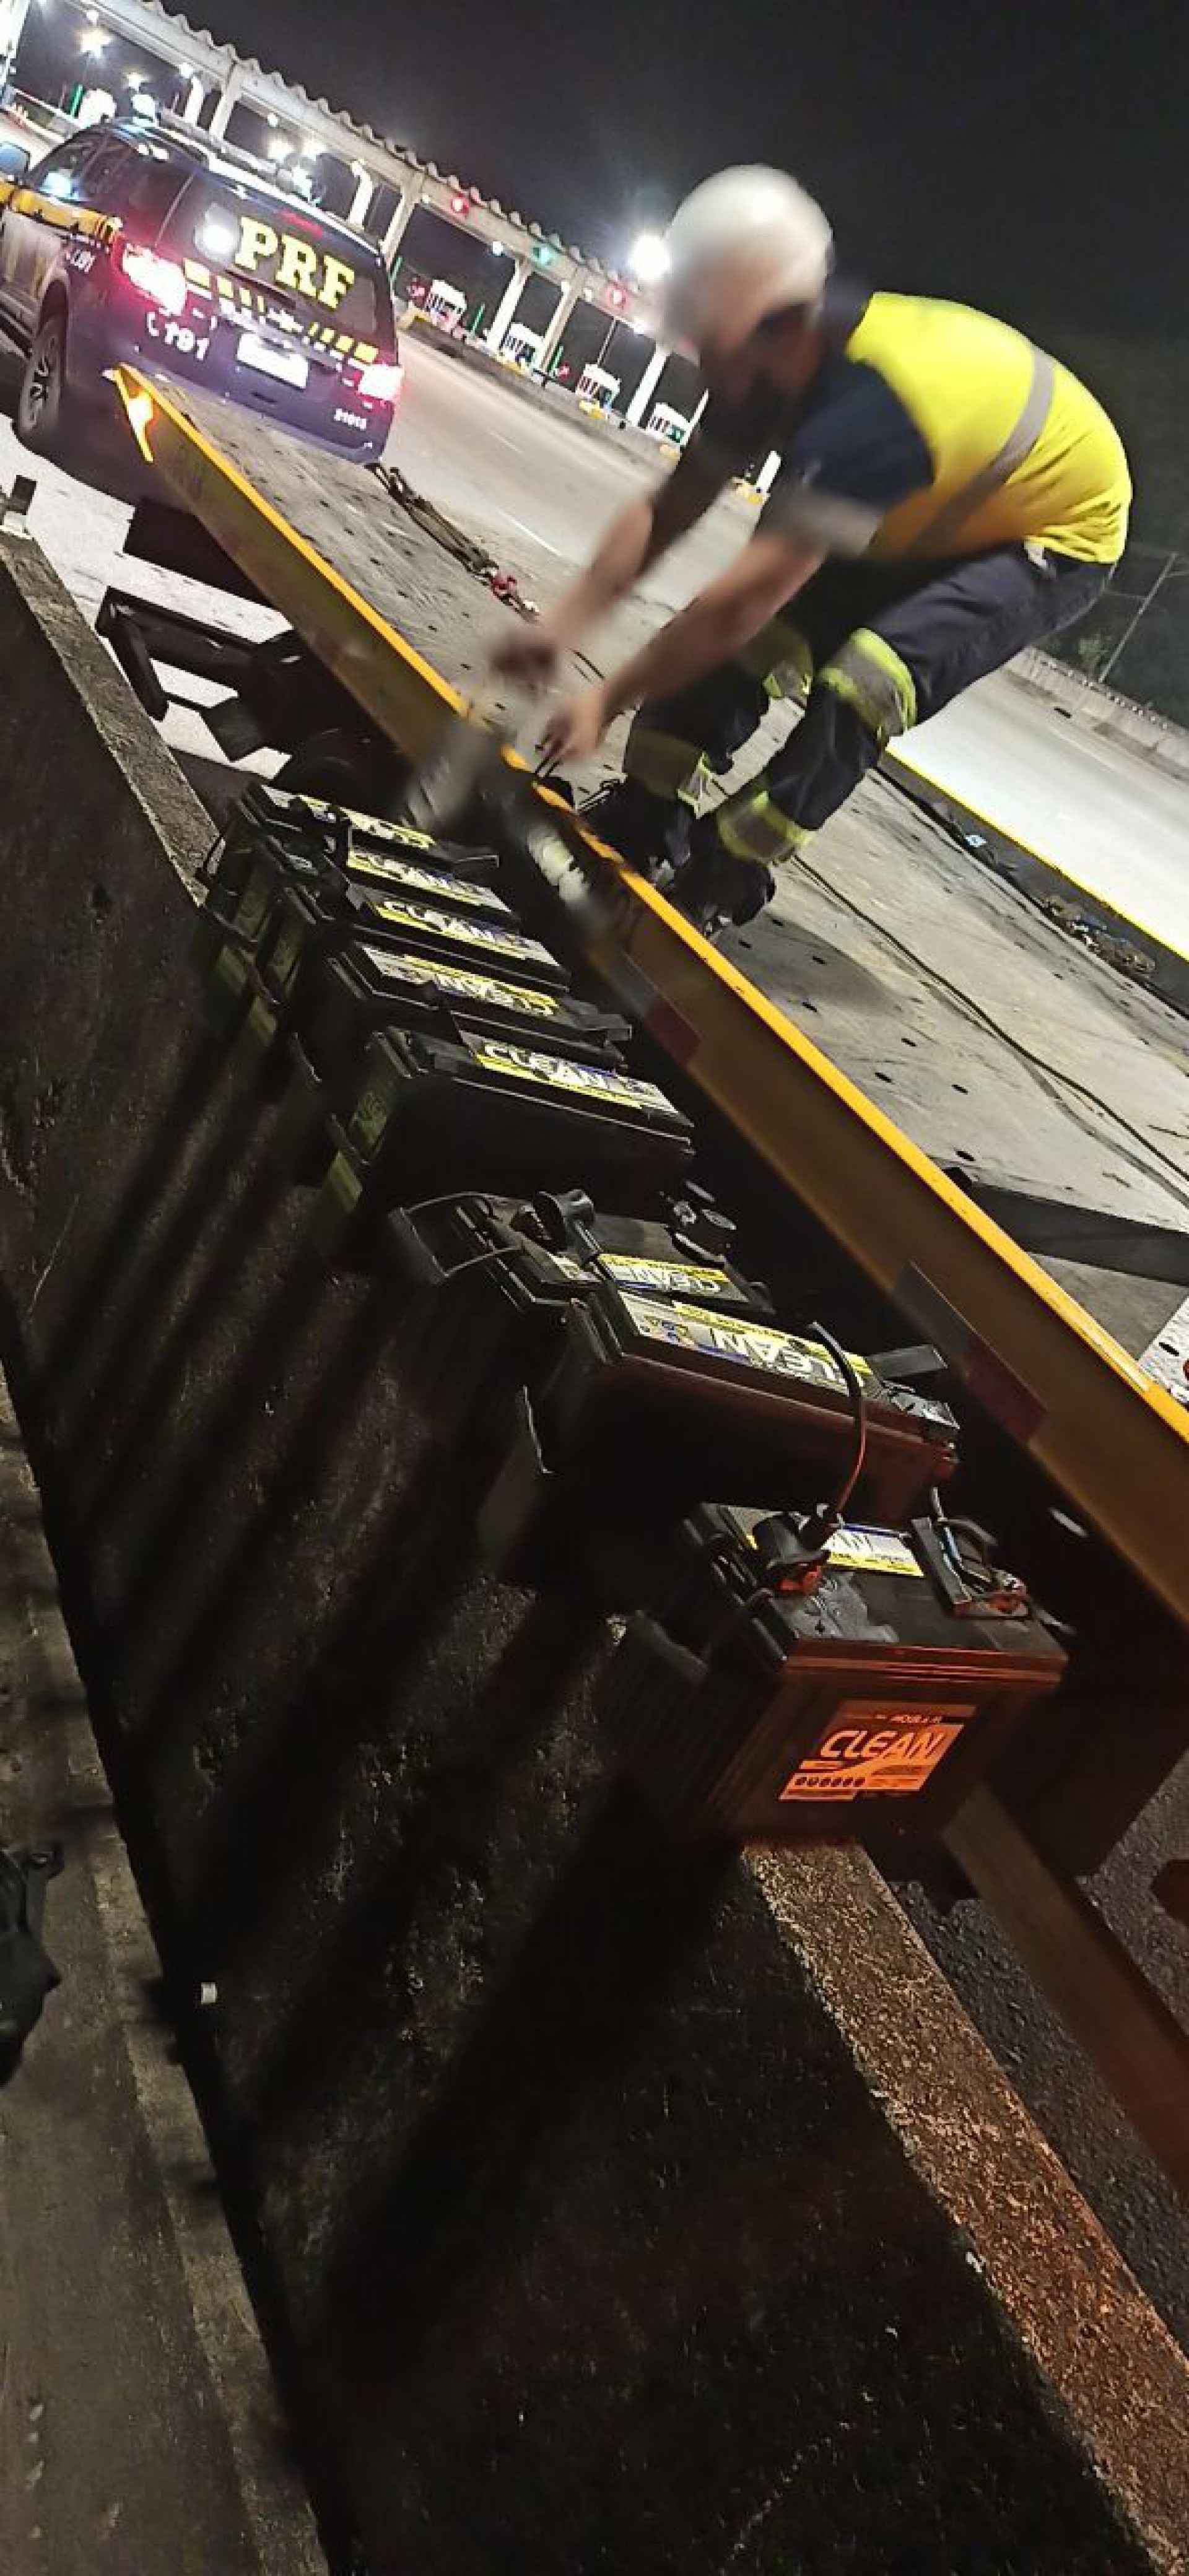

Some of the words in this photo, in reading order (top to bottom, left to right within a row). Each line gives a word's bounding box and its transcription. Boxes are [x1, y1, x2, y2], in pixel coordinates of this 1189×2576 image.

[235, 217, 354, 308] PRF
[165, 322, 210, 360] 191
[484, 1045, 610, 1090] CLEAN
[821, 1730, 946, 1759] CLEAN
